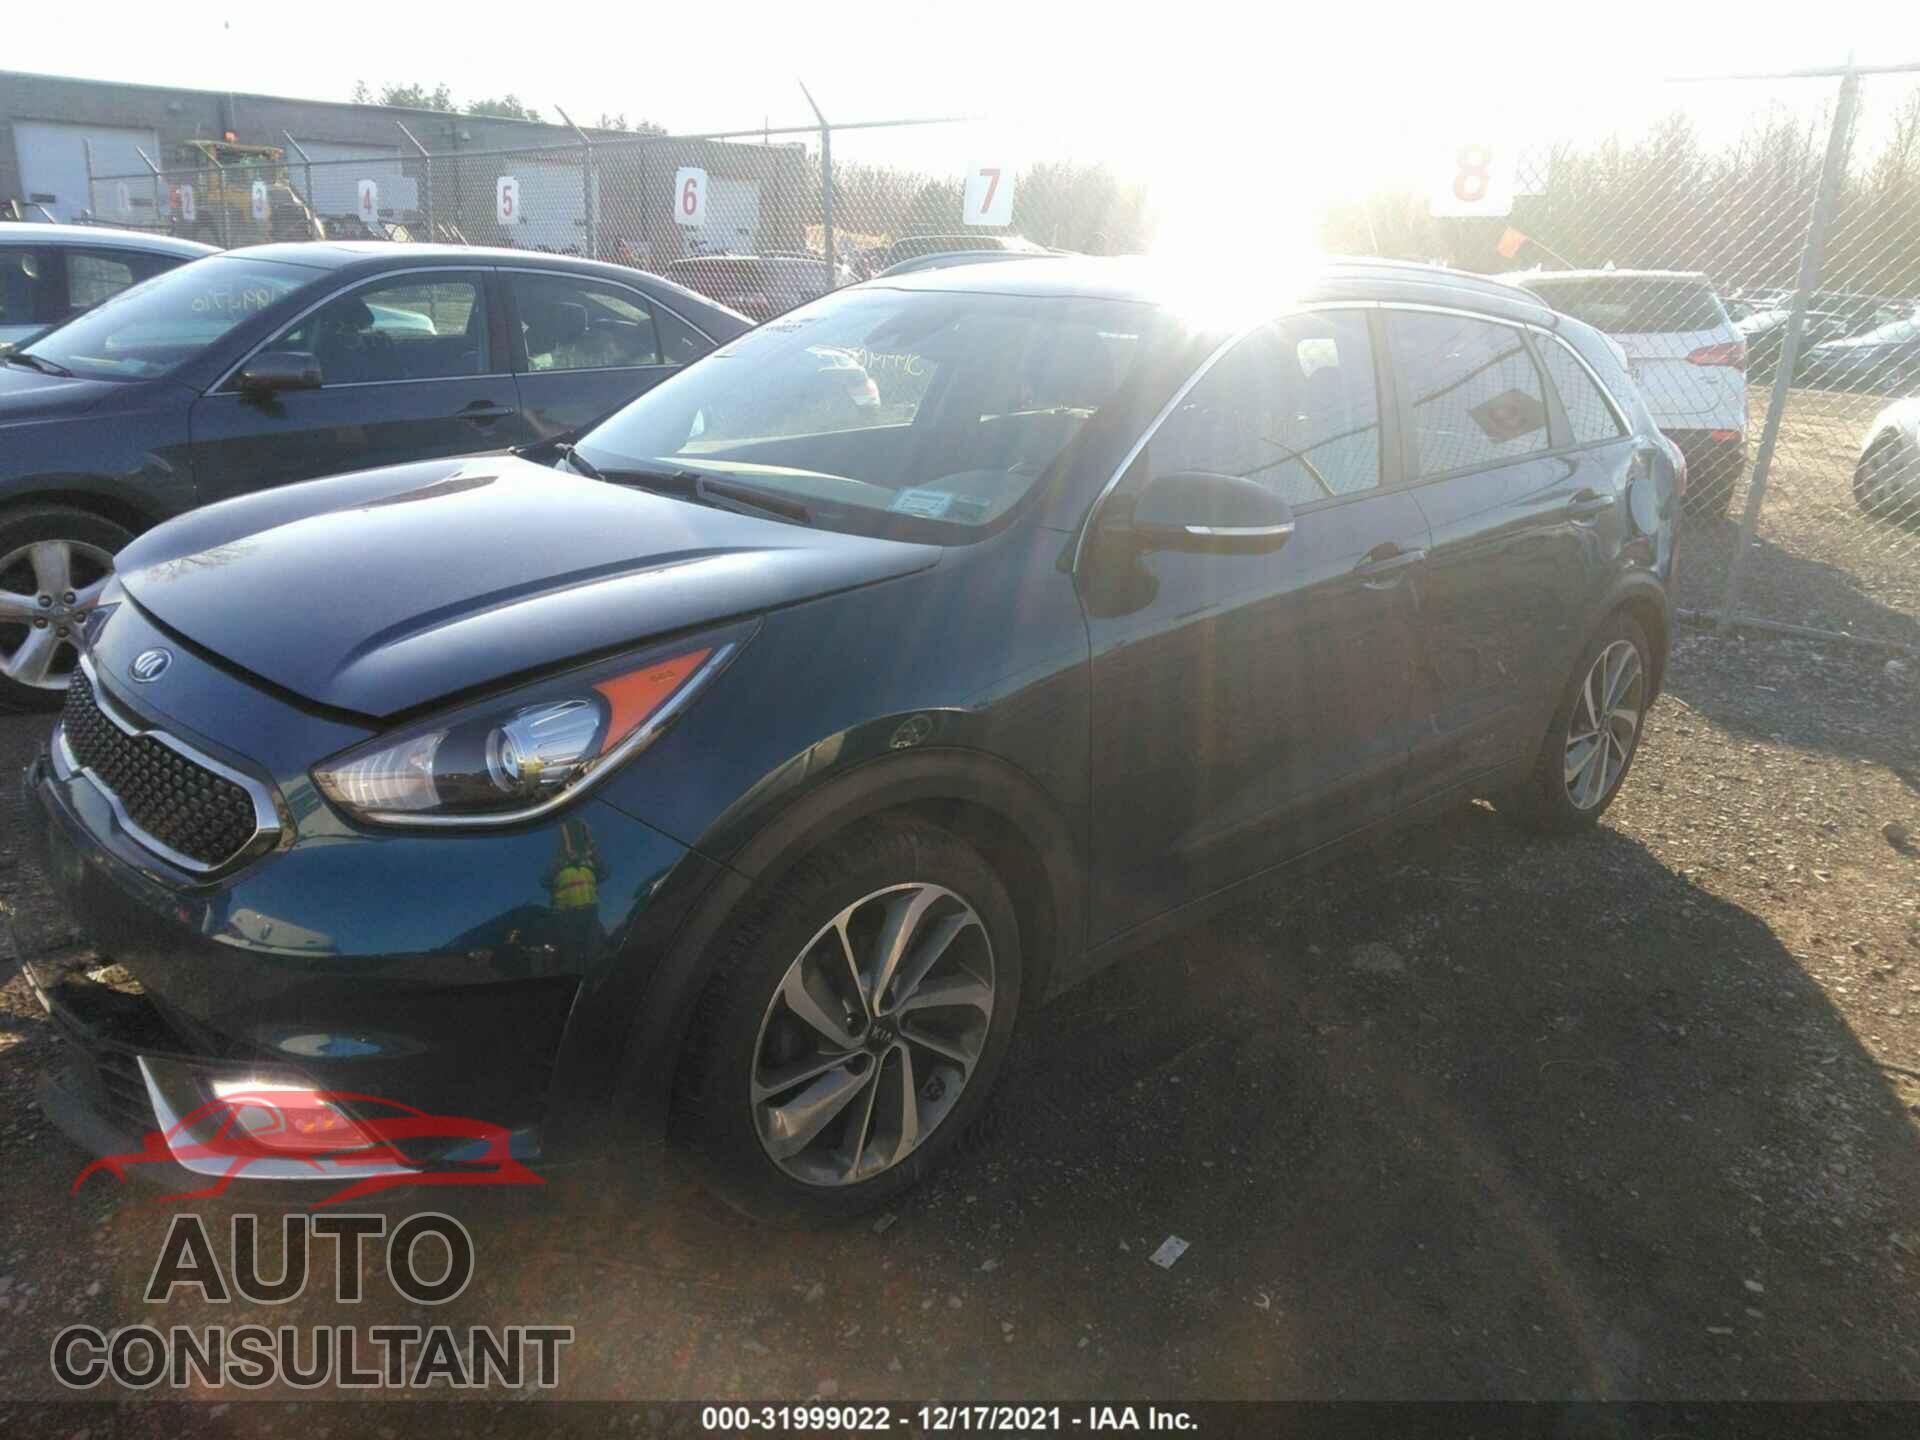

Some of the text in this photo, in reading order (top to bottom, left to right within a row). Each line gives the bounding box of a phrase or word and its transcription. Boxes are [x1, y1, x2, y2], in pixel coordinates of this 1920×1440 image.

[979, 168, 1001, 214] 7
[1453, 145, 1490, 202] 8
[362, 187, 372, 215] 4
[502, 185, 513, 216] 5
[682, 177, 697, 216] 6
